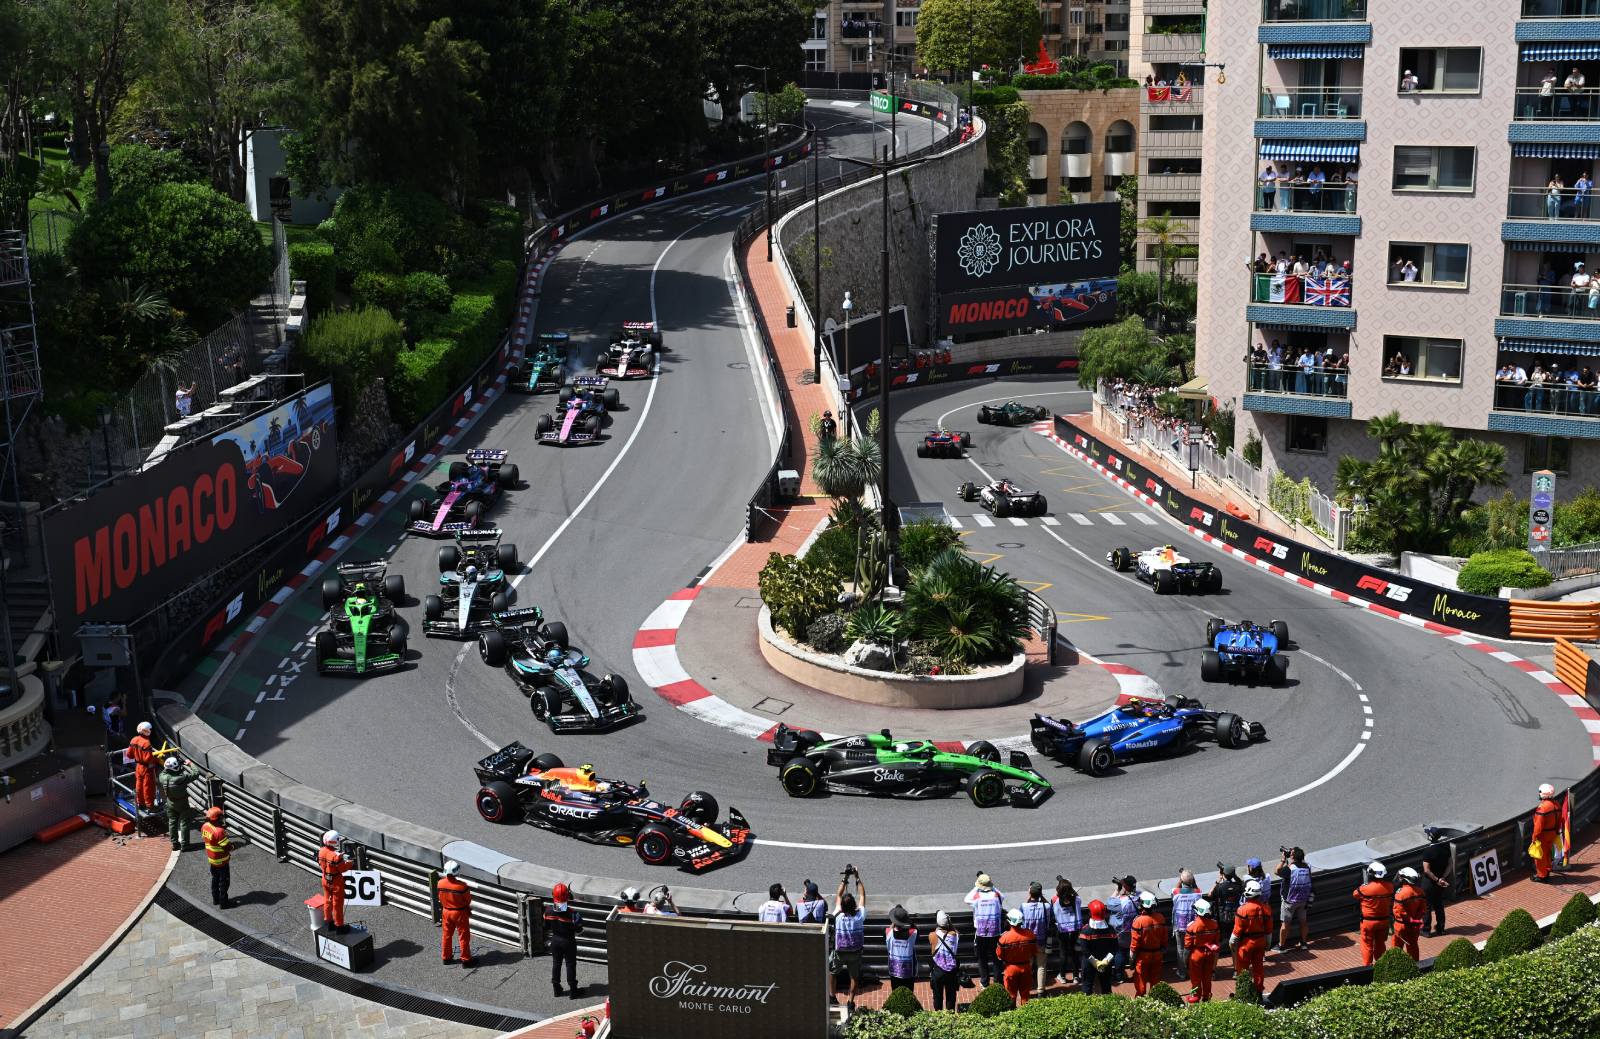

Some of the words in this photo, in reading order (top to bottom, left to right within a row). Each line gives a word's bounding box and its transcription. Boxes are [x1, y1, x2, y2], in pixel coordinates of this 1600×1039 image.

[1009, 218, 1096, 243] EXPLORA
[1007, 240, 1103, 271] JOURNEYS
[949, 298, 1030, 324] MONACO
[74, 463, 237, 615] MONACO
[1432, 593, 1481, 622] Monaco
[265, 648, 313, 701] TAXI
[846, 738, 865, 747] Stake
[1125, 739, 1158, 750] KOMATSU
[515, 778, 542, 787] HONDA
[874, 767, 905, 782] Stake
[549, 803, 599, 820] ORACLE
[1474, 856, 1497, 888] SC
[344, 875, 376, 901] SC
[649, 960, 781, 1004] Fairmont
[678, 1001, 714, 1012] MONTE
[718, 1004, 752, 1014] CARLO
